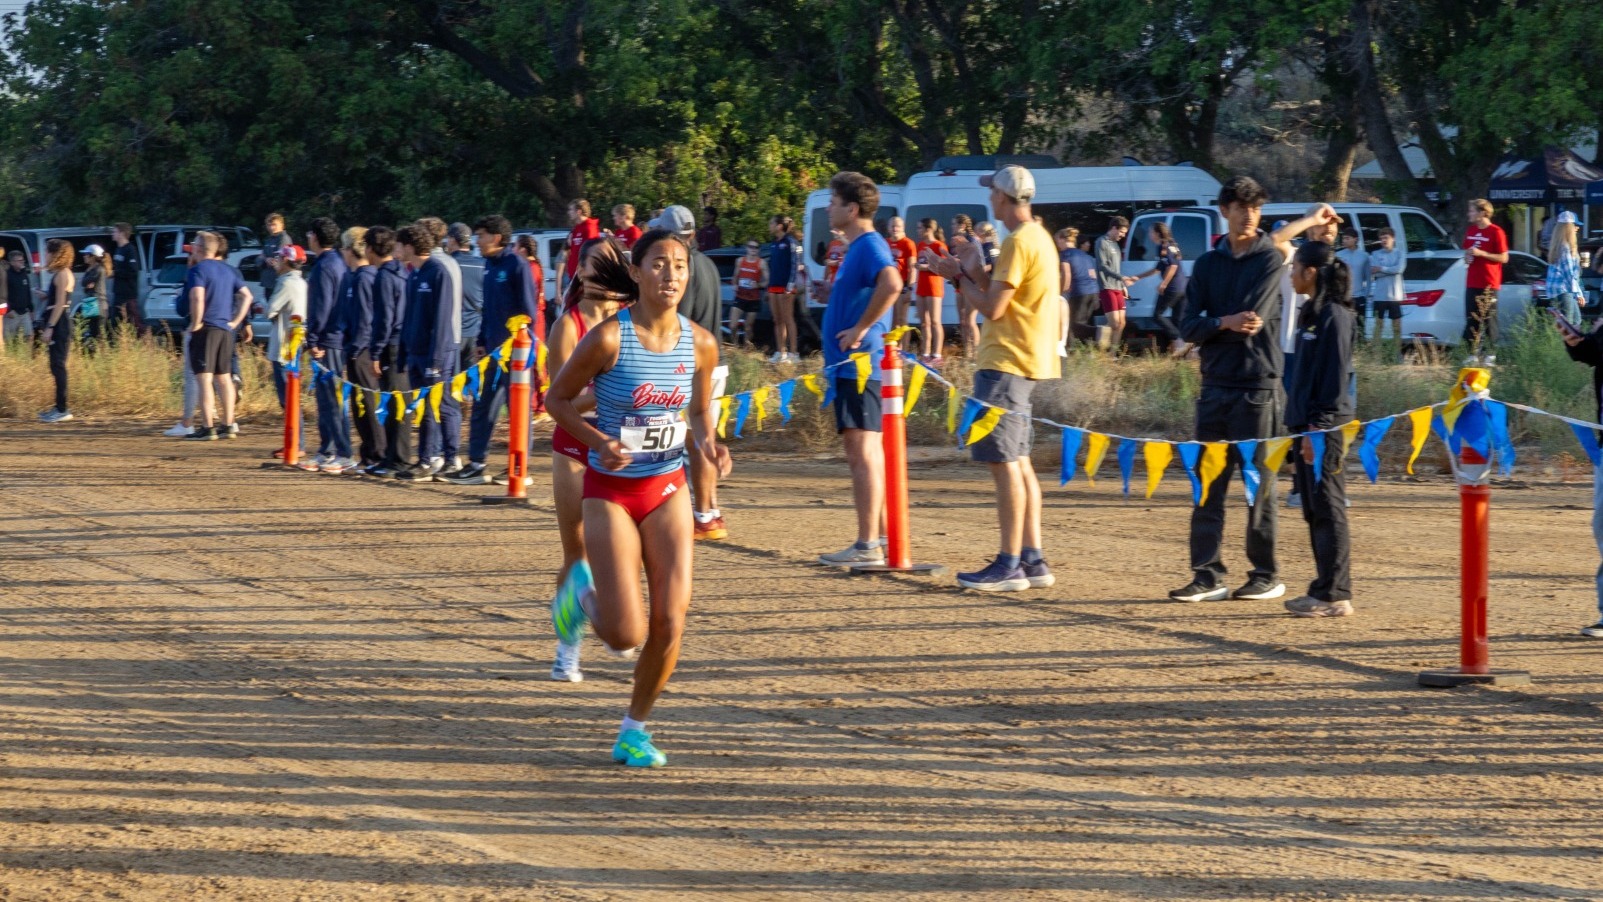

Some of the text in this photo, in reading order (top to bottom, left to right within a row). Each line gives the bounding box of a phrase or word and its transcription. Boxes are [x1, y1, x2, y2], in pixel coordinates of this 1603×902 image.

[1489, 189, 1546, 199] UNIVERSITY
[632, 382, 686, 409] Biola
[642, 426, 675, 450] 50
